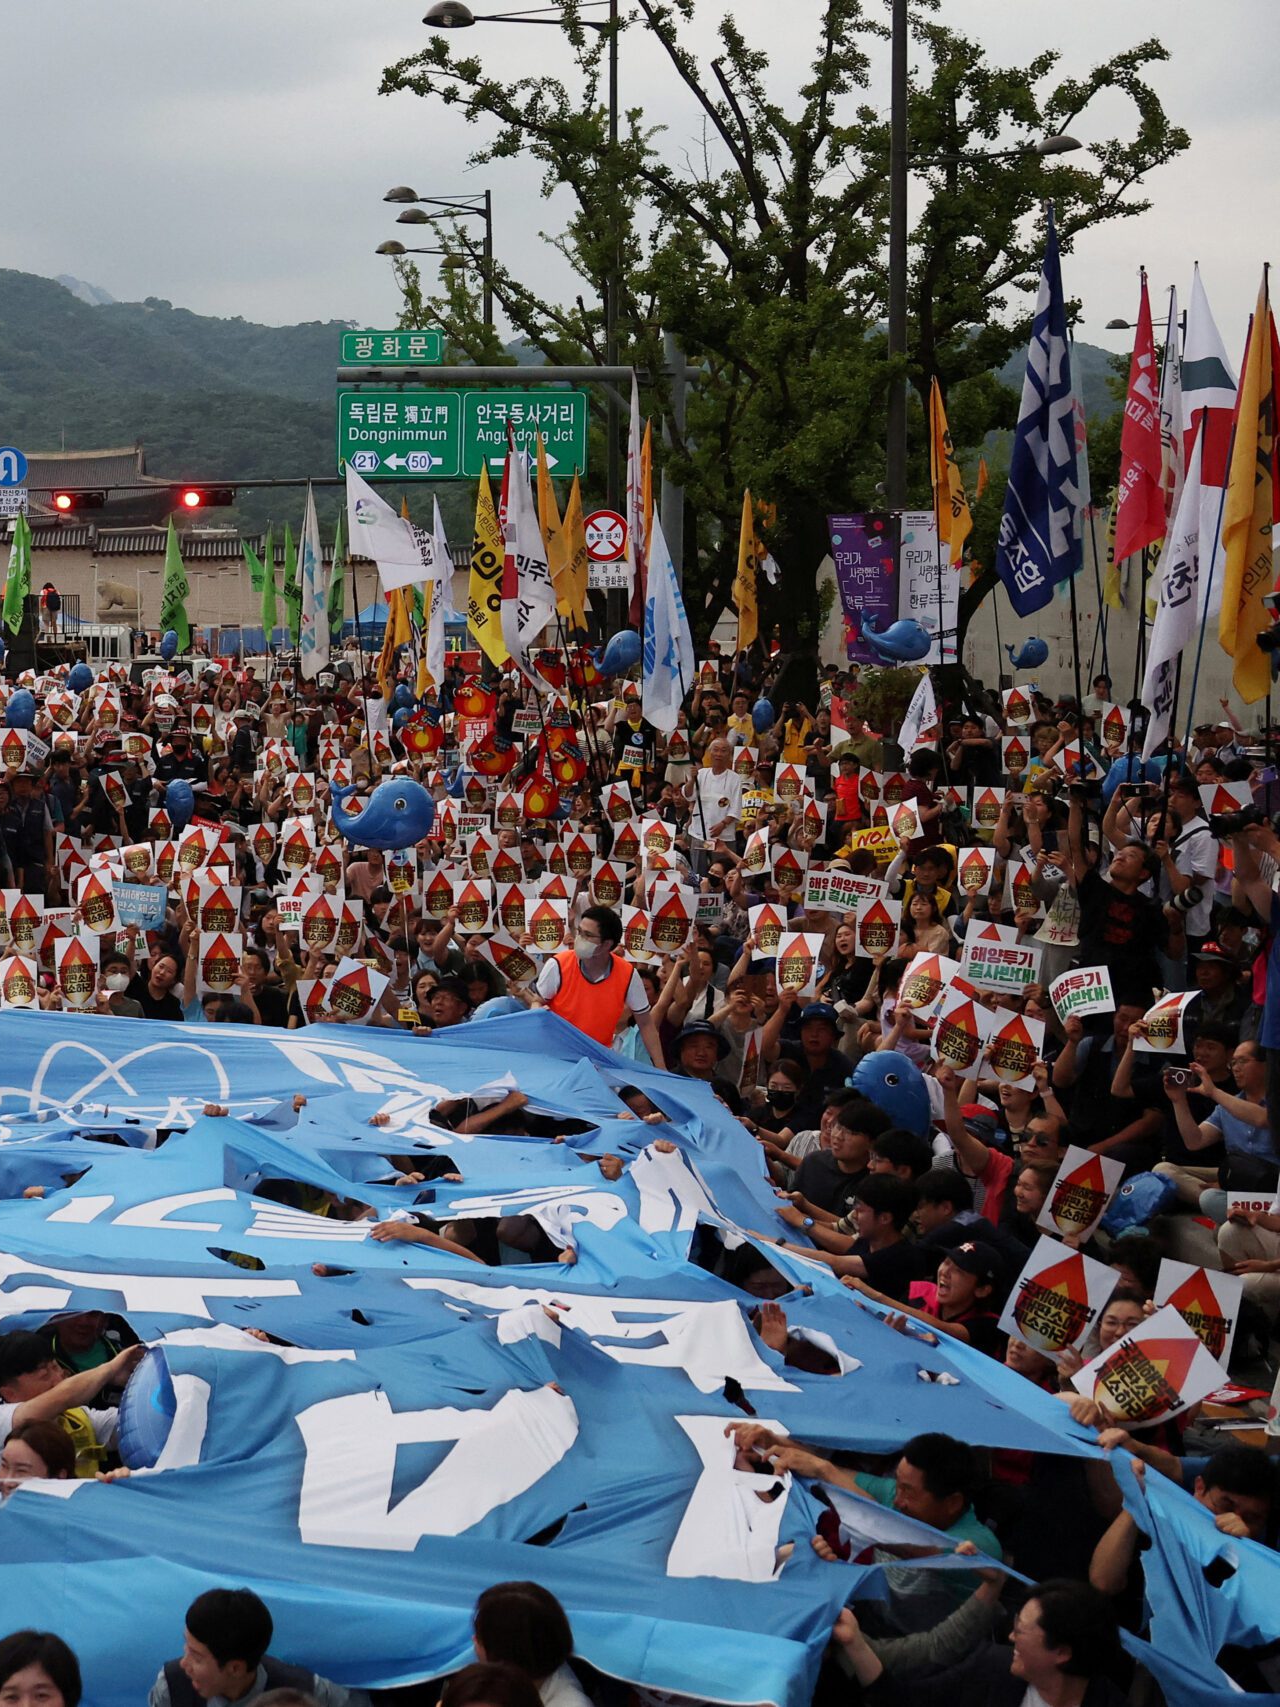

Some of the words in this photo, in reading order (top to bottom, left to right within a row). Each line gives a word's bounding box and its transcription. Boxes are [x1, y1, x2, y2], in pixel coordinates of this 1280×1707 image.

[355, 336, 428, 358] 광화문
[349, 403, 399, 424] 독립문
[404, 405, 448, 424] 獨立門
[476, 403, 574, 425] 안국동사거리
[349, 427, 447, 444] Dongnimmun
[476, 427, 549, 444] Angukdong
[553, 428, 574, 442] Jct
[357, 455, 375, 468] 21
[411, 455, 428, 468] 50
[835, 552, 862, 571] 우리가
[905, 550, 933, 568] 우리가
[858, 829, 891, 847] NO!
[830, 876, 881, 898] 해양투기
[971, 945, 1034, 968] 해양투기
[968, 962, 1036, 984] 결사반대!
[1051, 971, 1103, 1005] 해양투기
[1055, 985, 1110, 1020] 결사반대!
